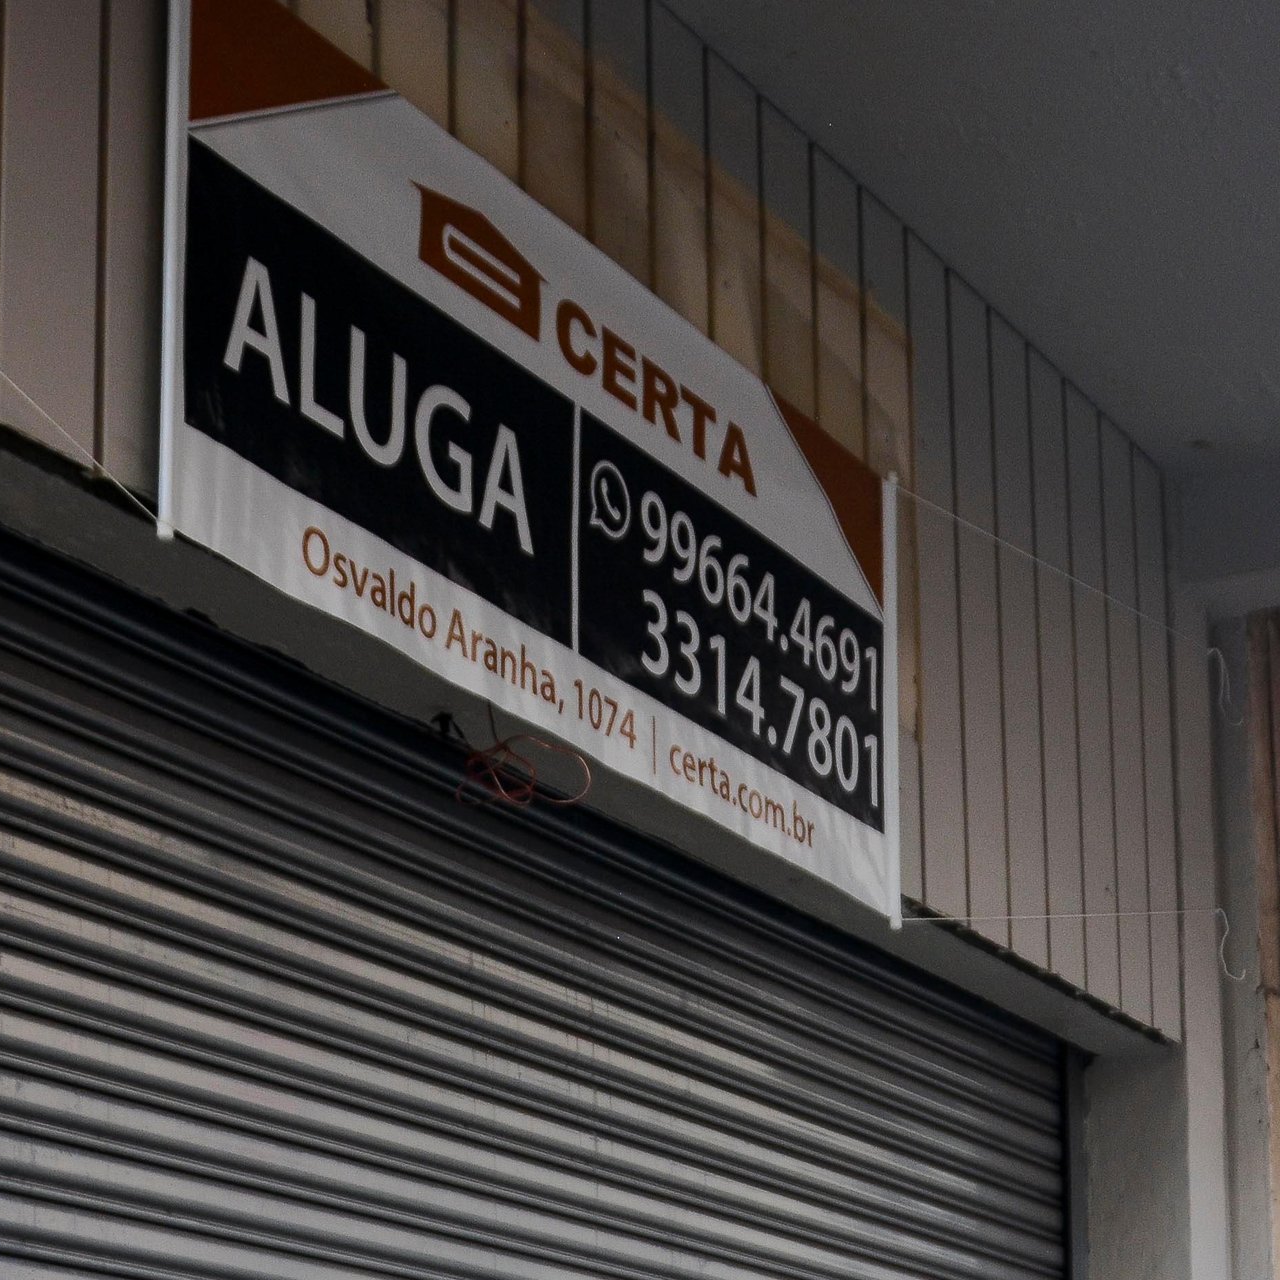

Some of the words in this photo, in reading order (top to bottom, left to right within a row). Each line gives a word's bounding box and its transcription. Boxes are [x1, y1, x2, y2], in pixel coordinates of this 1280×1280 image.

[222, 255, 535, 556] ALUGA
[556, 298, 758, 498] CERTA
[301, 525, 437, 641] Osvaldo
[446, 619, 567, 716] Aranha,
[573, 678, 638, 749] 1074
[669, 741, 816, 849] certa.com.br
[641, 489, 881, 711] 99664.4691
[641, 589, 883, 808] 3314.7801
